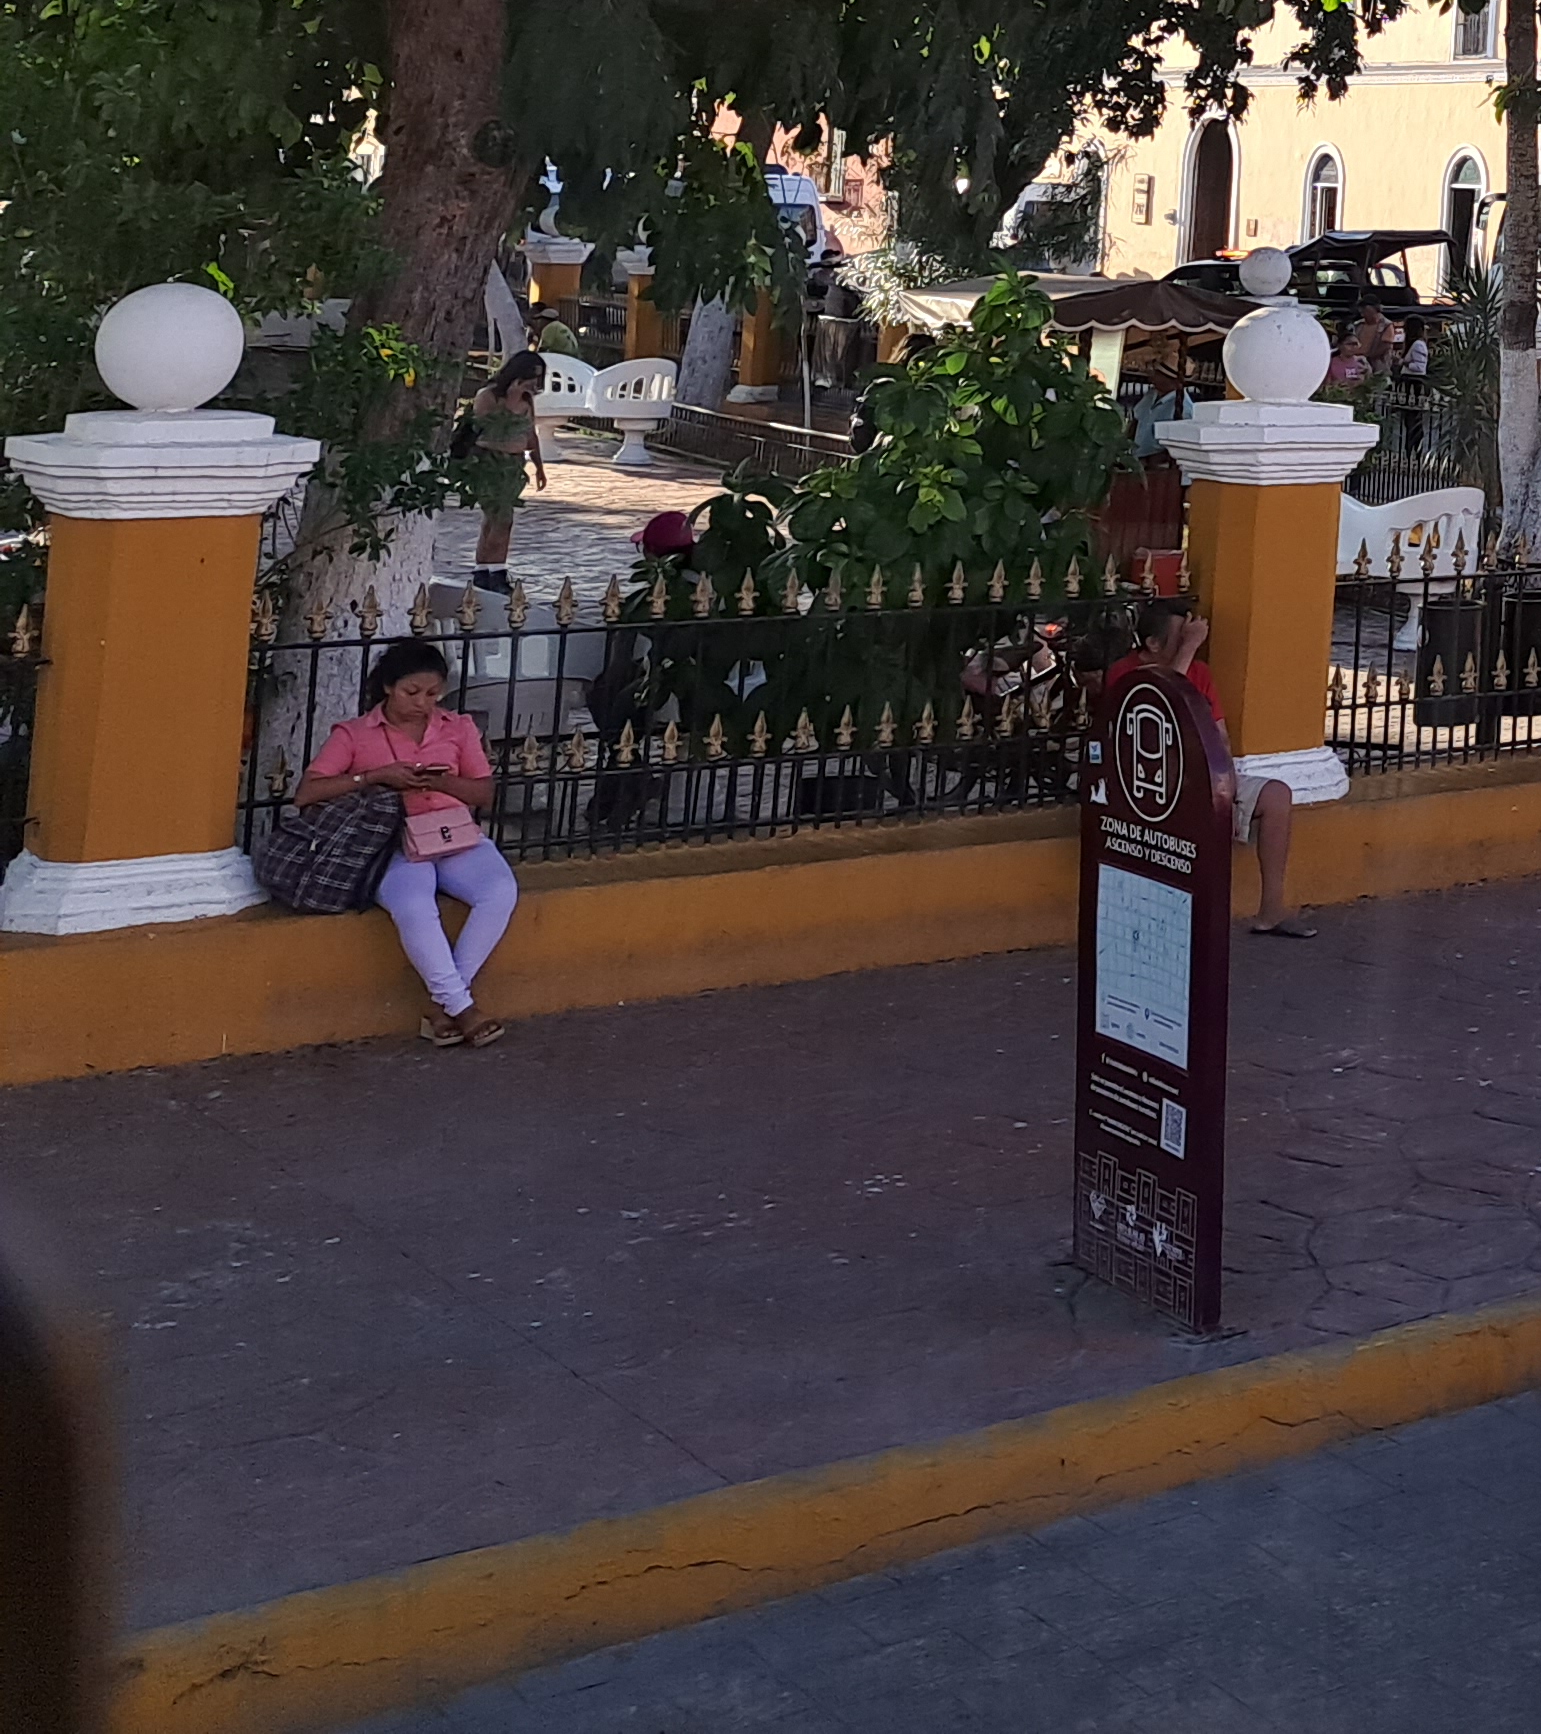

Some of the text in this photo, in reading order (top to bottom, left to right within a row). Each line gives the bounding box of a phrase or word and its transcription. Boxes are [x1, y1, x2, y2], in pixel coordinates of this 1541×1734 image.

[1100, 815, 1197, 858] ZONA DE AUTOBUSES
[1104, 835, 1192, 874] ASCENSO Y DESCENSO
